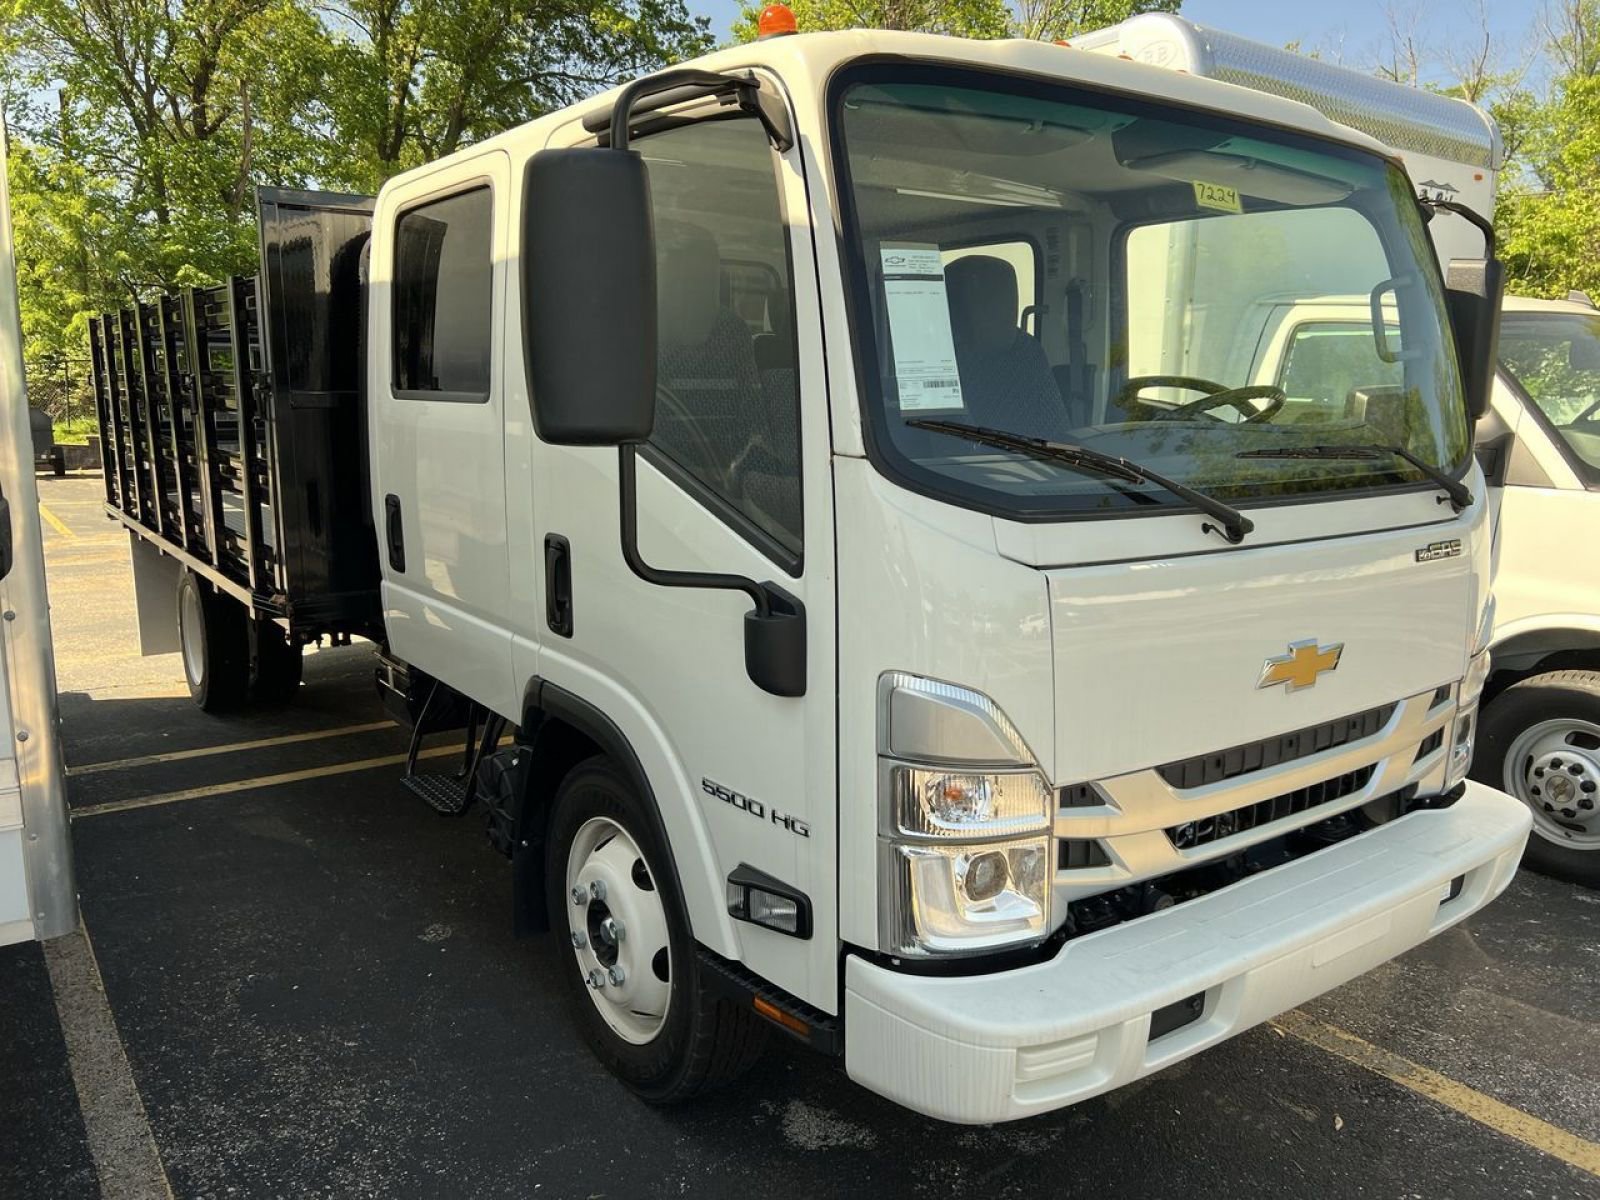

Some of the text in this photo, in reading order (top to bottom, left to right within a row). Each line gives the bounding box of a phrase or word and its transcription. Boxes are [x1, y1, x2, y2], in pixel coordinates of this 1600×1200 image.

[1197, 183, 1236, 204] 7224
[702, 777, 810, 838] 5500 HG
